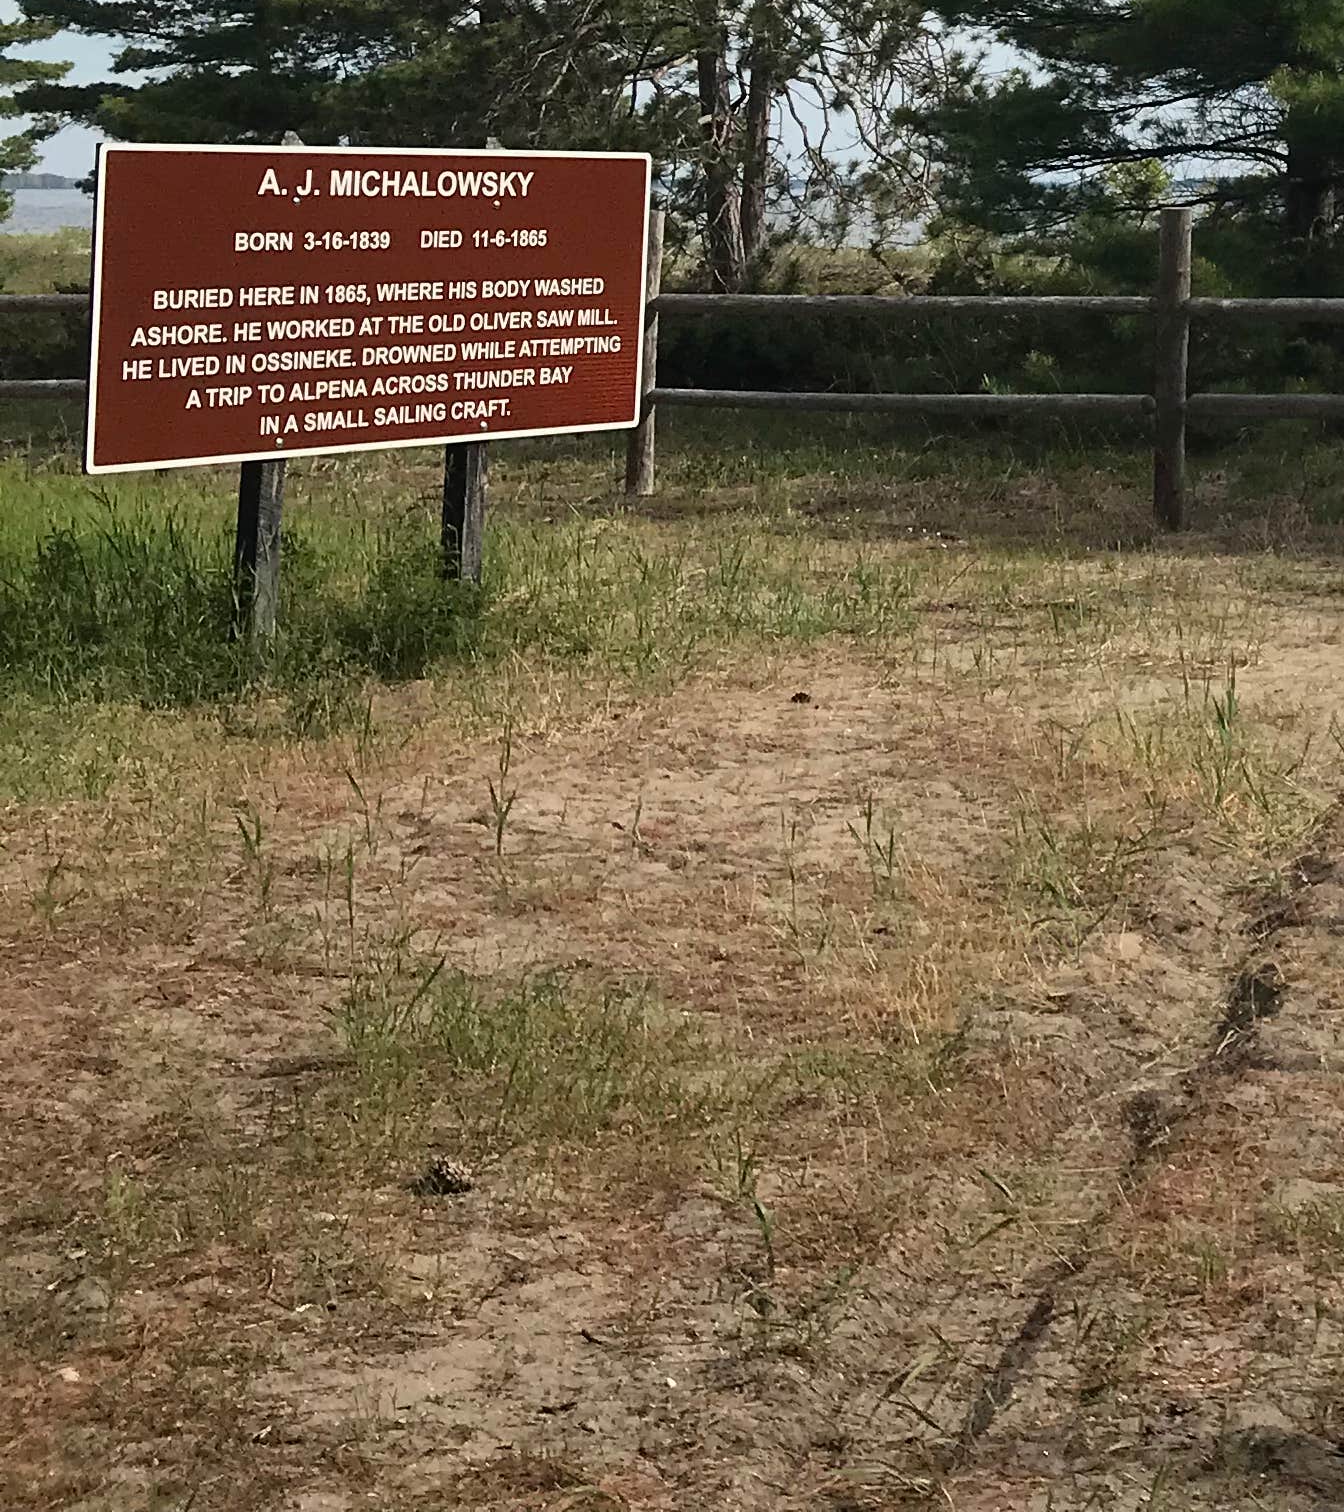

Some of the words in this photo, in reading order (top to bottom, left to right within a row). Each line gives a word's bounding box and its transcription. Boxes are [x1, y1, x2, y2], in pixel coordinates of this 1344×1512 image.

[257, 168, 288, 196] A.
[296, 169, 320, 196] J.
[329, 169, 535, 197] MICHALOWSKY
[234, 231, 294, 252] BORN
[303, 231, 391, 251] 3-16-1839
[420, 230, 463, 249] DIED
[472, 229, 547, 248] 11-6-1865
[153, 288, 234, 310] BURIED
[239, 286, 295, 307] HERE
[299, 285, 320, 305] IN
[324, 284, 371, 306] 1865,
[376, 281, 444, 302] WHERE
[448, 281, 477, 300] HIS
[481, 279, 531, 299] BODY
[534, 277, 604, 297] WASHED
[130, 323, 228, 347] ASHORE.
[233, 321, 262, 342] HE
[266, 318, 355, 340] WORKED
[358, 316, 384, 336] AT
[387, 315, 425, 335] THE
[428, 313, 466, 333] OLD
[469, 311, 533, 331] OLIVER
[536, 309, 575, 328] SAW
[577, 308, 618, 327] MILL.
[122, 359, 153, 381] HE
[158, 356, 220, 378] LIVED
[225, 354, 246, 375] IN
[251, 348, 357, 373] OSSINEKE.
[361, 343, 457, 366] DROWNED
[460, 340, 516, 361] WHILE
[518, 335, 621, 358] ATTEMPTING
[185, 389, 202, 409] A
[205, 386, 253, 408] TRIP
[257, 383, 285, 404] TO
[288, 378, 368, 402] ALPENA
[371, 373, 449, 396] ACROSS
[452, 368, 536, 391] THUNDER
[539, 365, 573, 385] BAY
[260, 415, 280, 436] IN
[283, 414, 299, 434] A
[303, 409, 370, 432] SMALL
[373, 402, 447, 426] SAILING
[450, 398, 511, 420] CRAFT.
